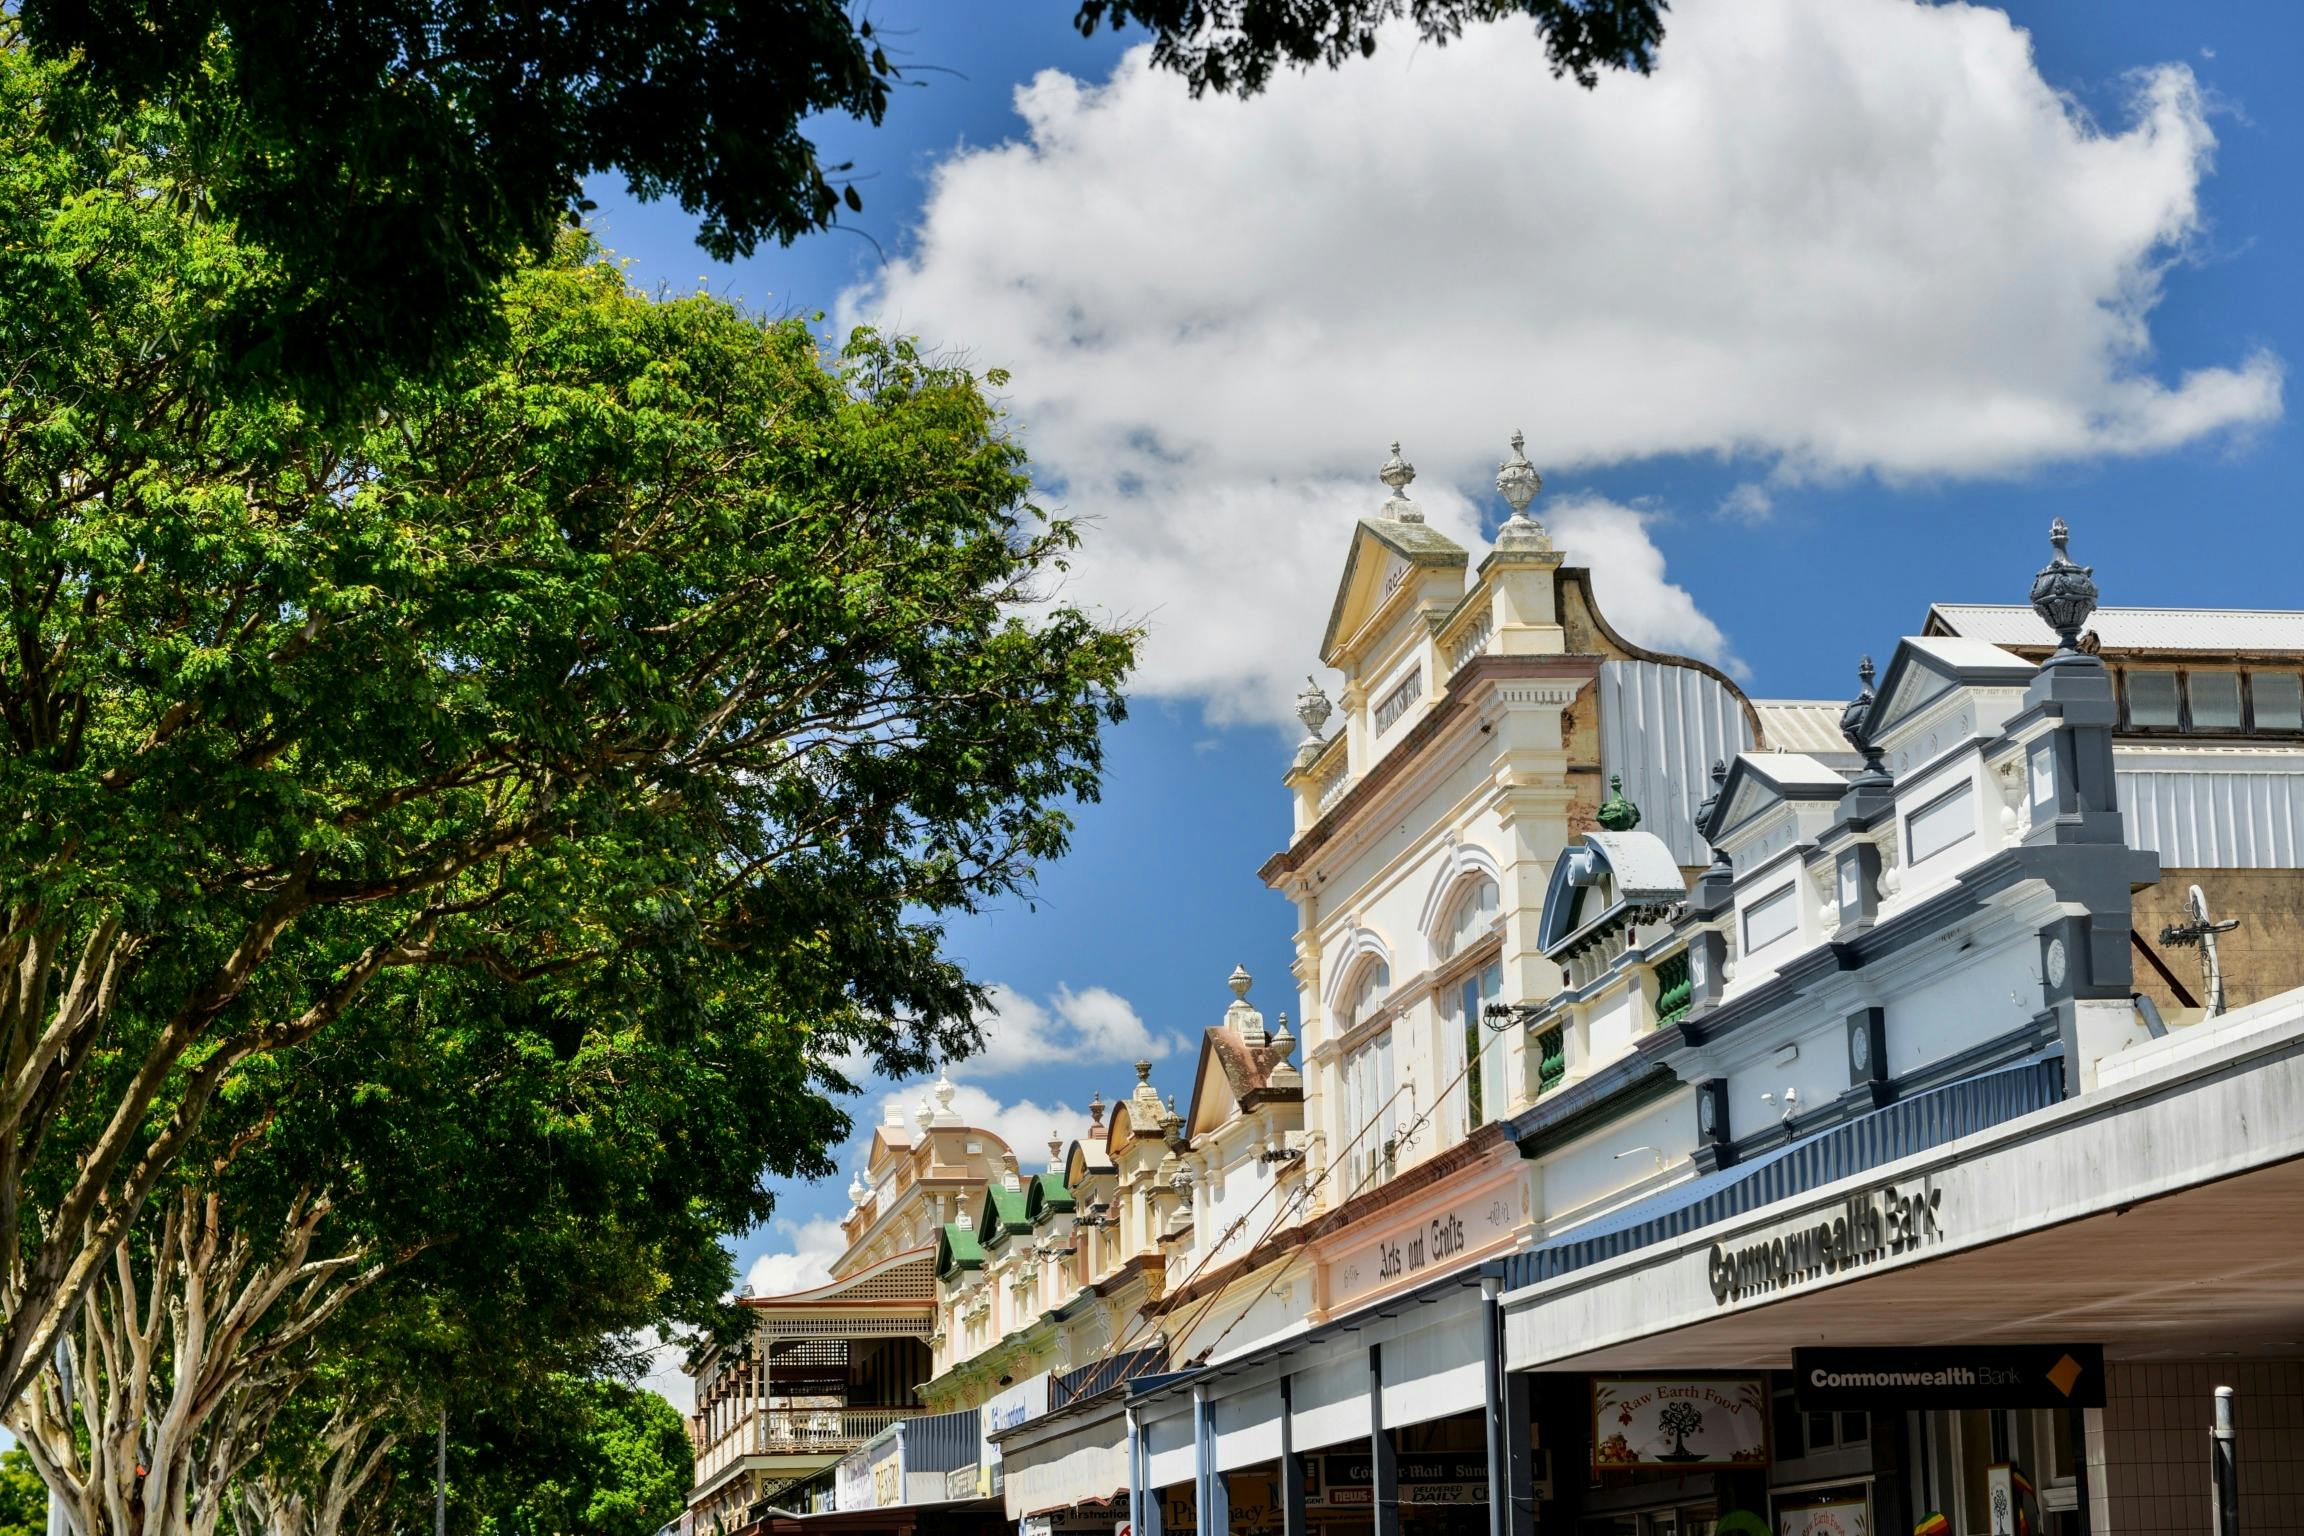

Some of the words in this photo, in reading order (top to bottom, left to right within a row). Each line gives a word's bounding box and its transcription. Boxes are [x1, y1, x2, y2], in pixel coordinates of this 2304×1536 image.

[1379, 1240, 1402, 1284] Arts
[1408, 1227, 1425, 1271] and
[1430, 1211, 1464, 1261] Crafts
[1709, 1196, 1885, 1301] Commonwealth
[1885, 1176, 1943, 1248] Bank
[1811, 1367, 1975, 1388] Commonwealth
[1978, 1366, 2022, 1386] Bank
[1619, 1392, 1653, 1414] Raw
[1656, 1384, 1700, 1400] Earth
[1704, 1388, 1743, 1416] Food
[1412, 1492, 1463, 1502] DAILY
[1413, 1485, 1463, 1493] DELIVERED
